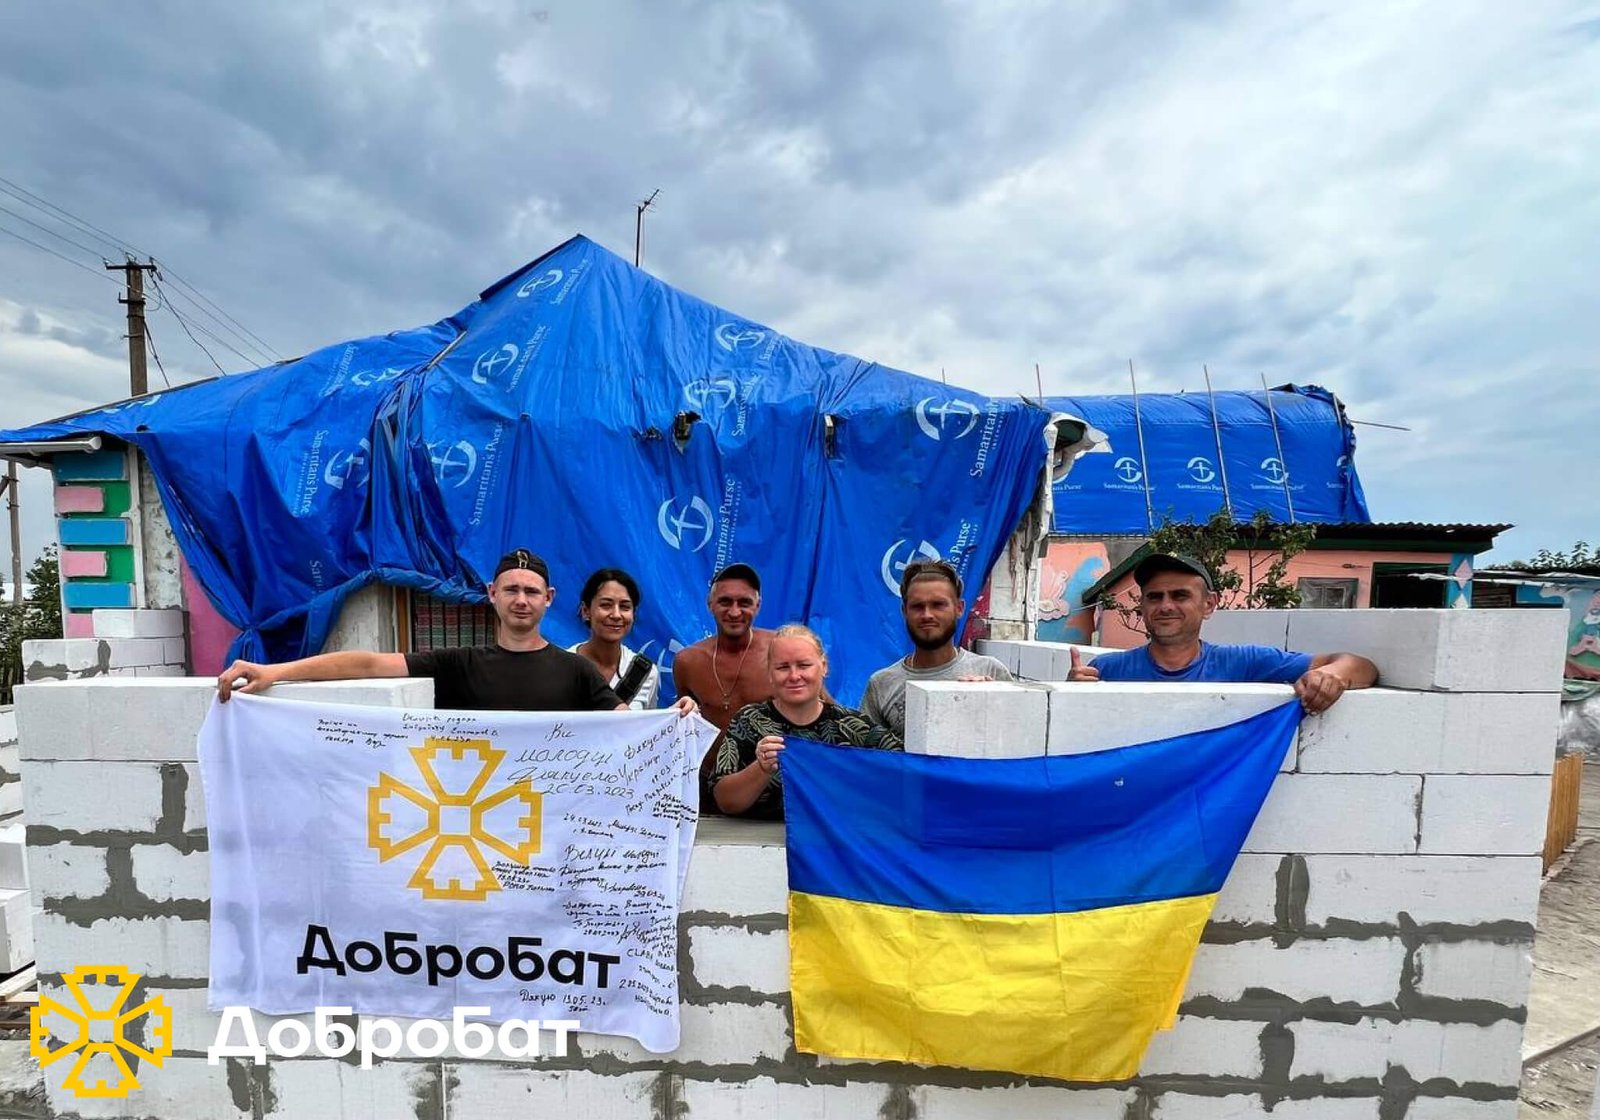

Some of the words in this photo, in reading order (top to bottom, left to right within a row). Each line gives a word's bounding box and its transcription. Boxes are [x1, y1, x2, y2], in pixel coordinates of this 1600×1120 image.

[719, 478, 736, 515] Purse
[950, 520, 971, 557] Purse
[296, 924, 622, 989] Добробат
